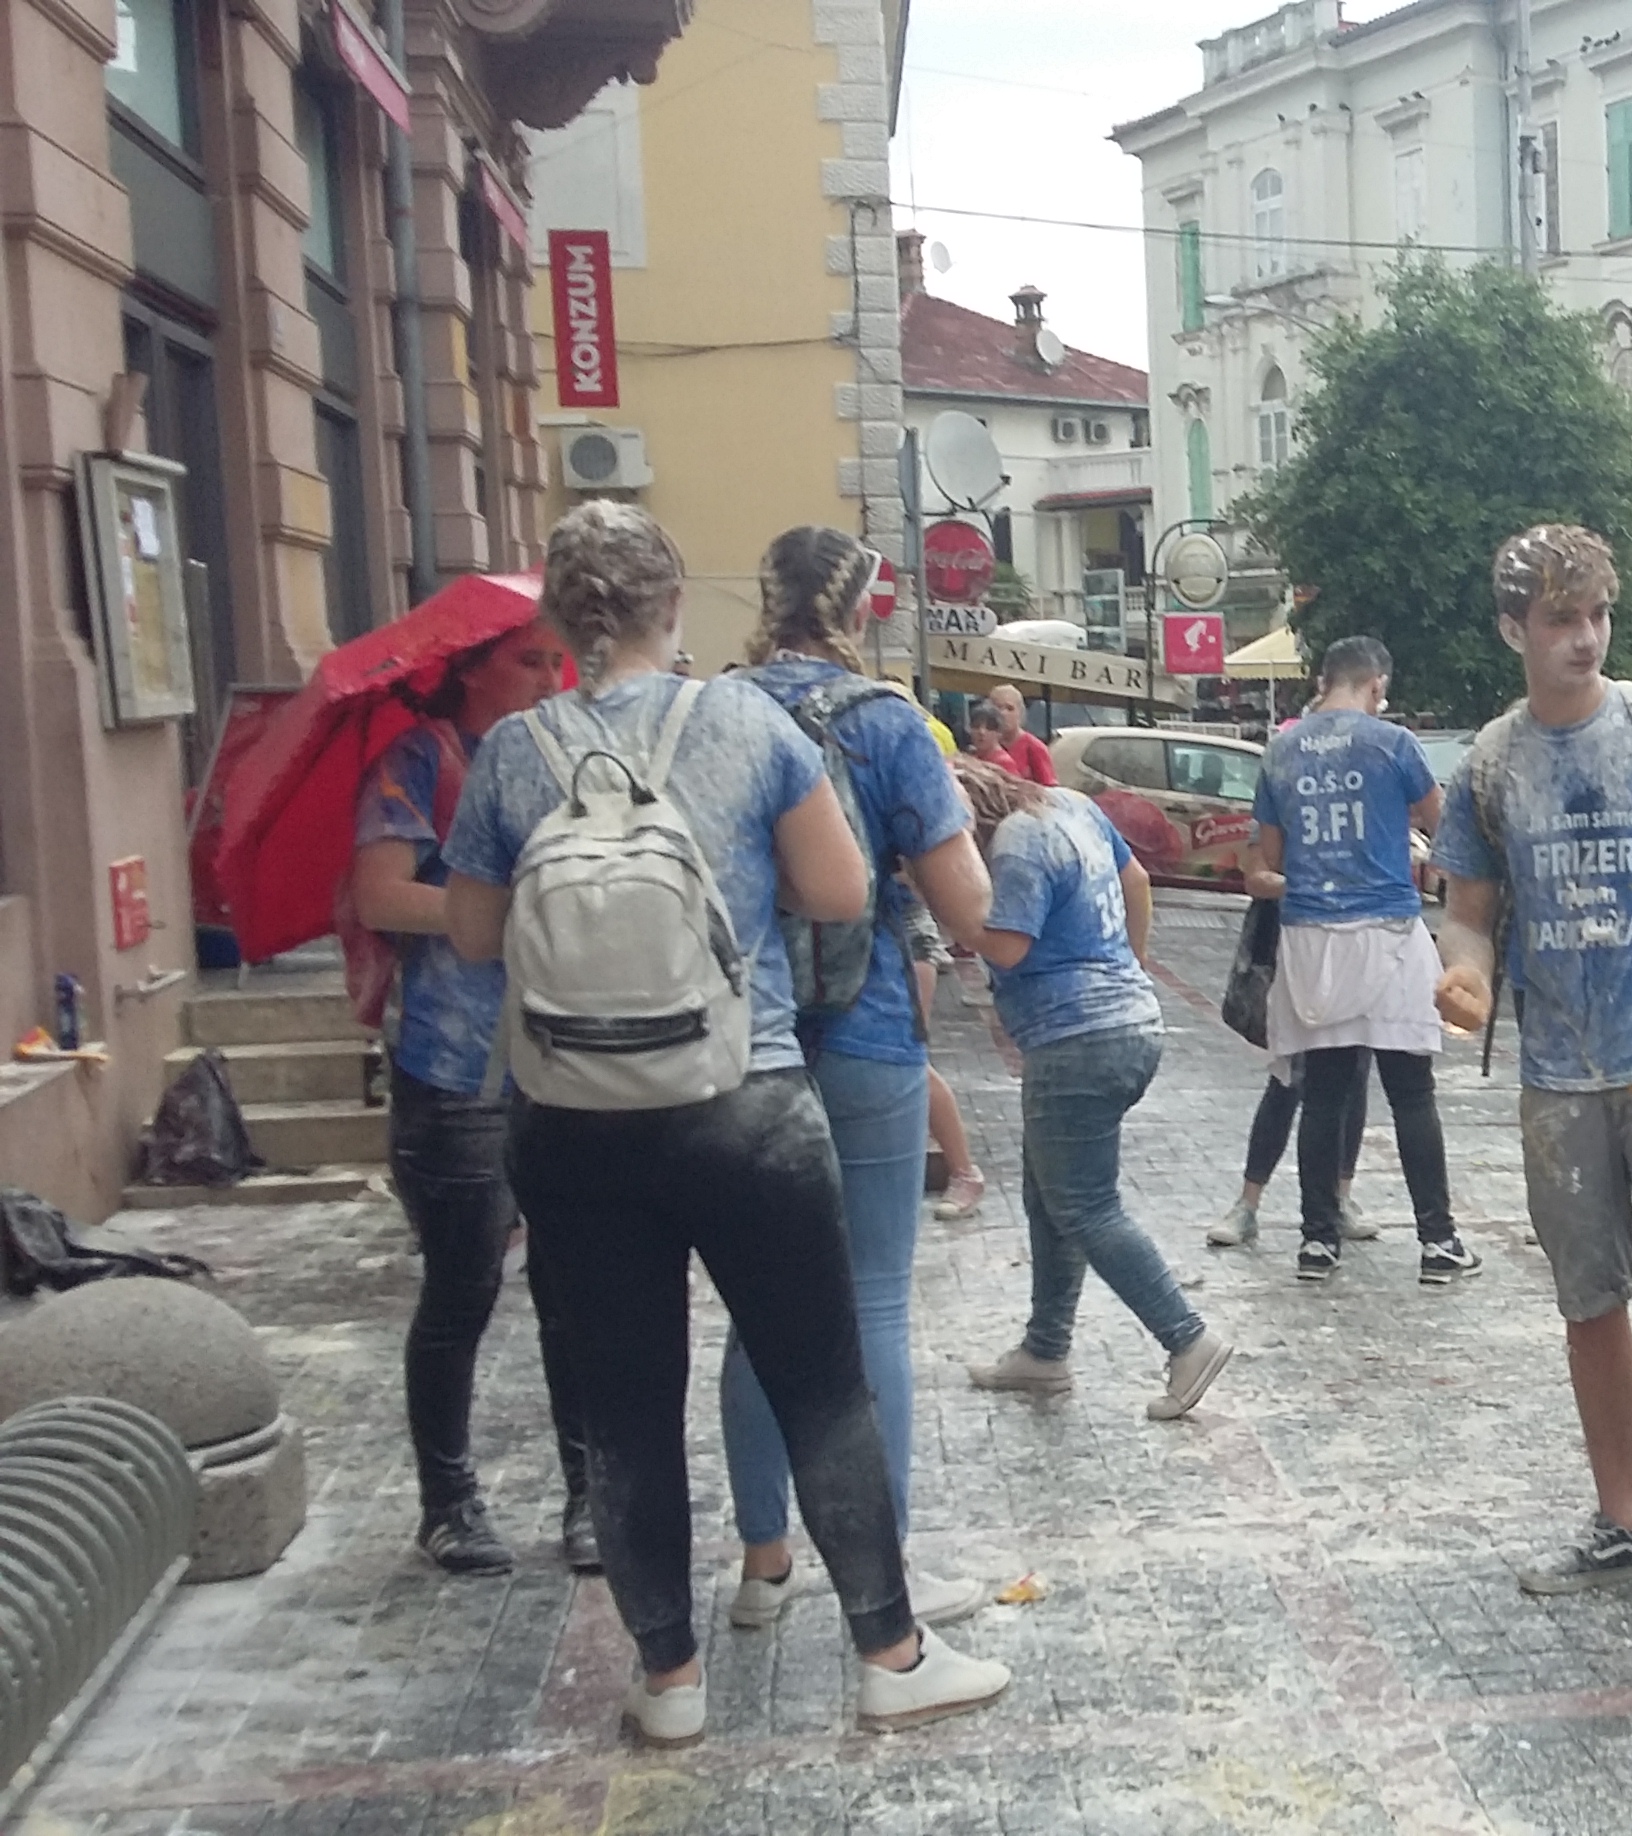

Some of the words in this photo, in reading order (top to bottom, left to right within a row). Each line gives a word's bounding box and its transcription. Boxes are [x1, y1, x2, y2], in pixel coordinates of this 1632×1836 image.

[564, 244, 603, 393] KONZUM
[943, 639, 1047, 675] MAXI
[1070, 659, 1143, 690] BAR
[1551, 812, 1589, 831] sam
